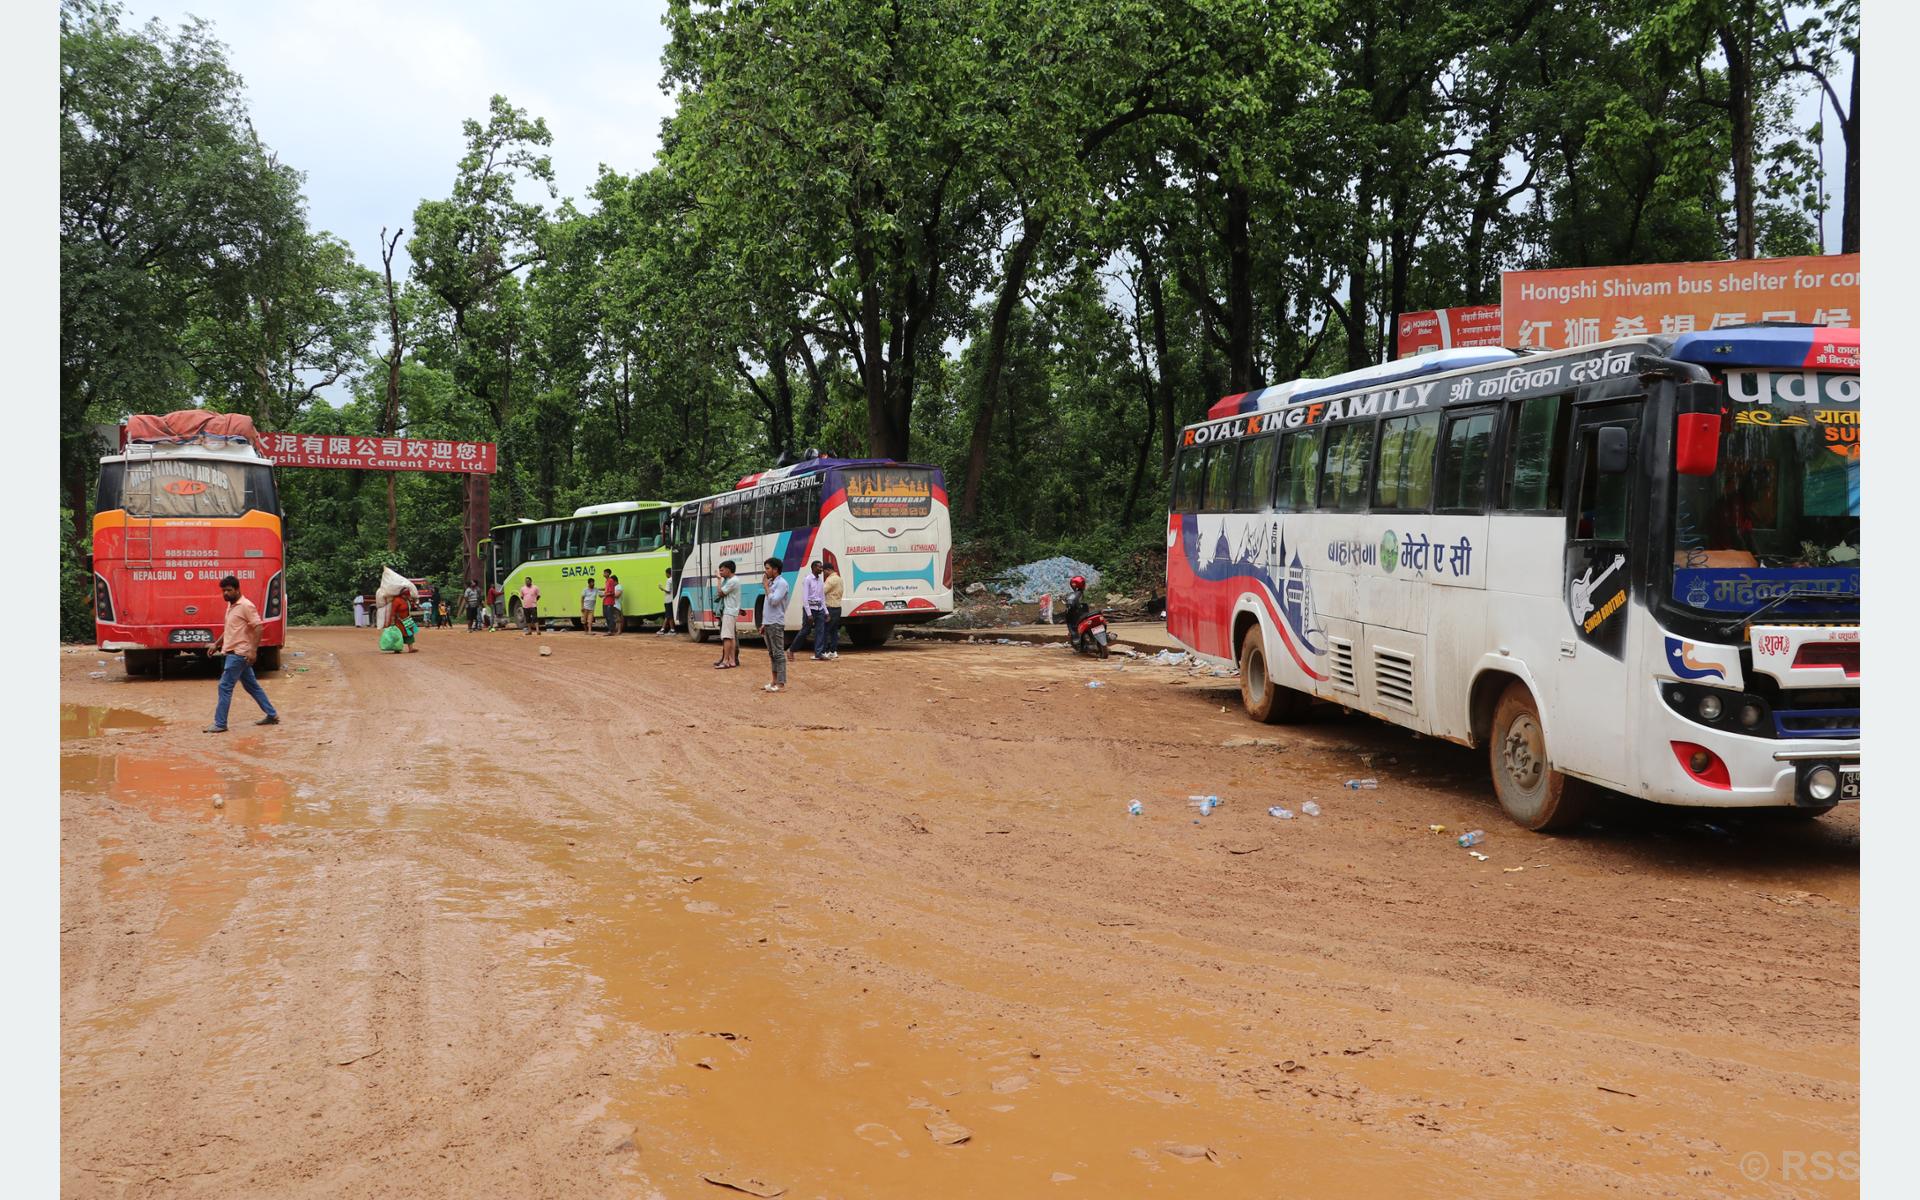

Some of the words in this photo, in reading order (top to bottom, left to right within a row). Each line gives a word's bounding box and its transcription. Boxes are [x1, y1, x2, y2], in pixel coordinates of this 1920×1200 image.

[1521, 280, 1597, 304] Hongshi
[1602, 278, 1671, 298] Shivam
[1678, 275, 1713, 294] bus
[1718, 272, 1787, 292] shelter
[1793, 269, 1824, 288] for
[1412, 319, 1438, 328] HONGSHI
[1449, 377, 1474, 402] श्री
[1477, 367, 1564, 397] कालिका
[1569, 350, 1635, 382] दर्शन
[1183, 424, 1247, 447] ROYAL
[1247, 410, 1306, 435] KING
[1306, 382, 1440, 425] FAMILY
[197, 465, 210, 483] AIR
[212, 469, 229, 490] BUS
[262, 454, 301, 464] ngshi
[308, 454, 362, 466] Shivam
[368, 457, 422, 468] Cement
[428, 460, 455, 470] Pvt.
[461, 461, 487, 471] Ltd.
[1434, 544, 1445, 573] ए
[1450, 536, 1472, 577] सी
[133, 571, 177, 580] NEPALGUNJ
[237, 570, 256, 579] BENI
